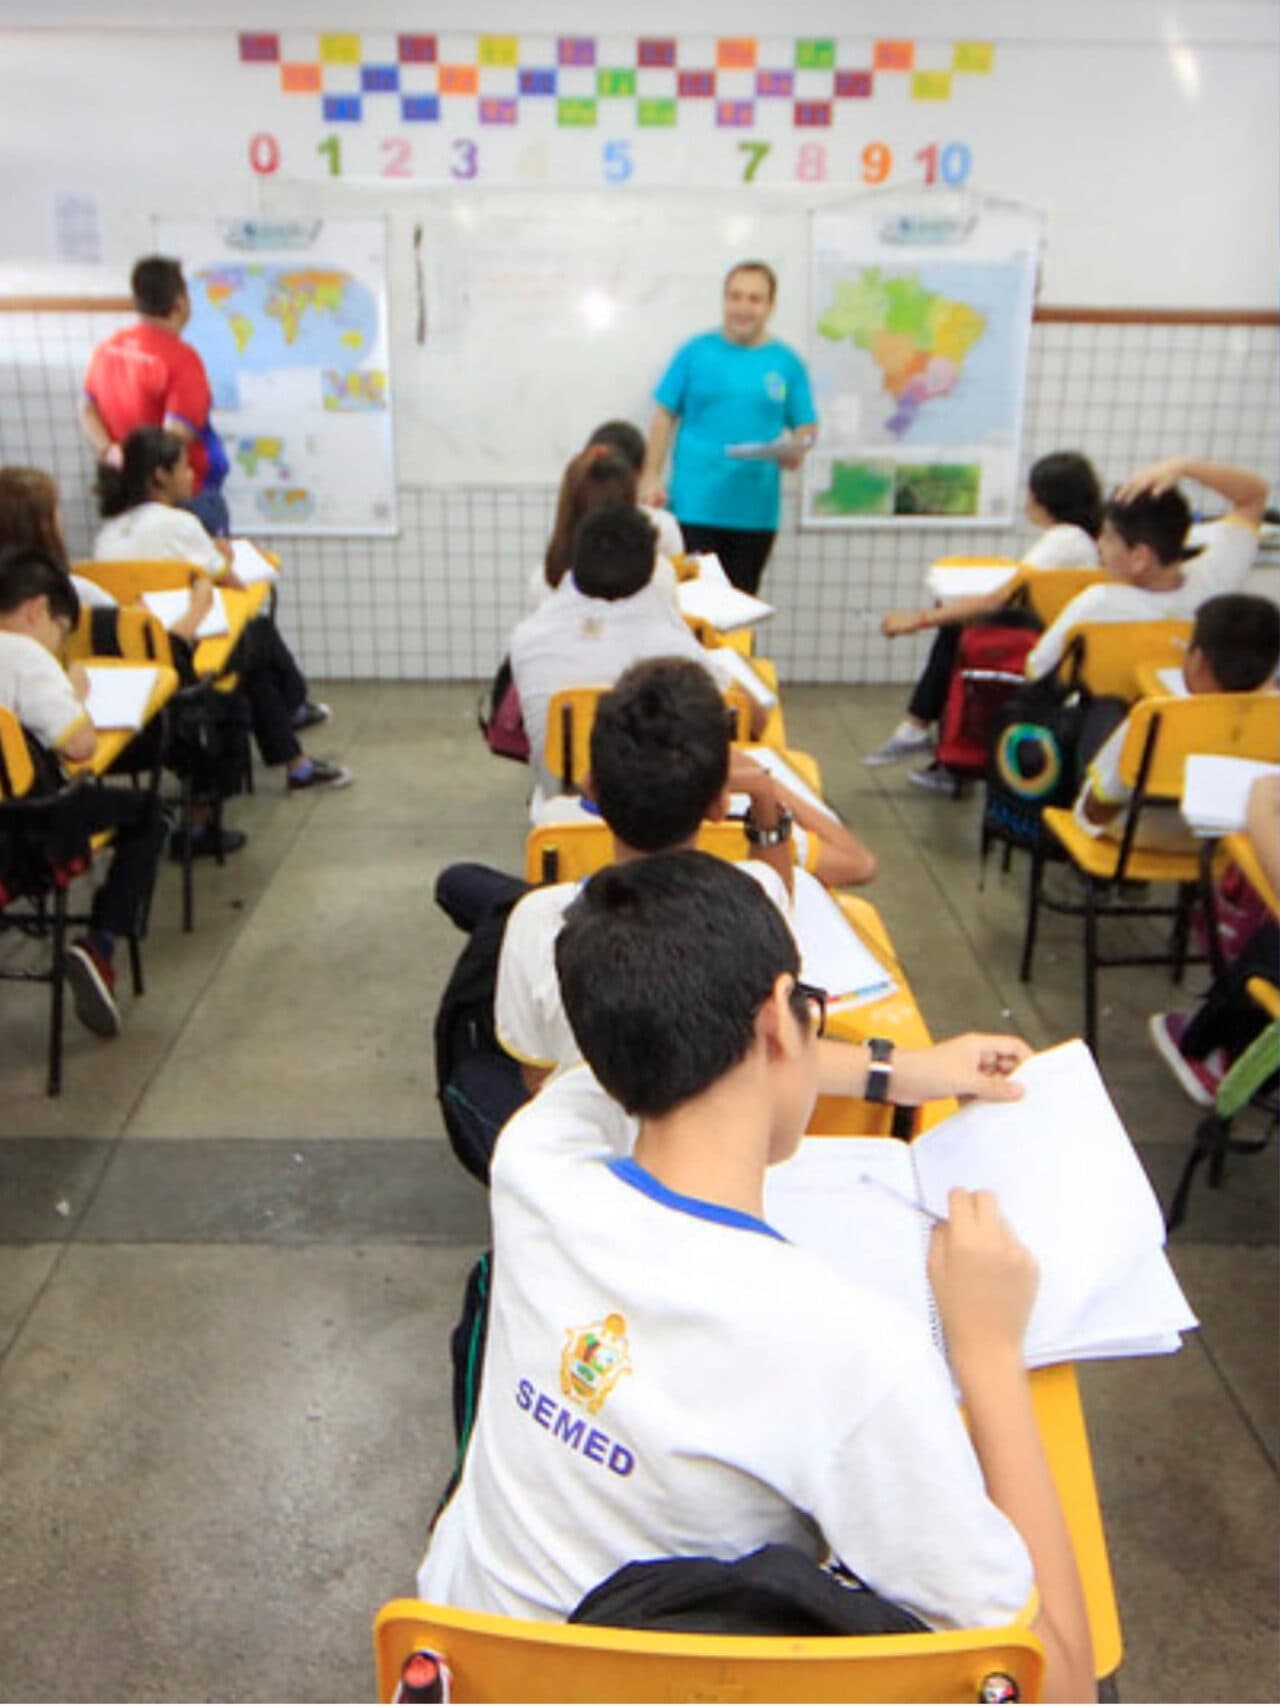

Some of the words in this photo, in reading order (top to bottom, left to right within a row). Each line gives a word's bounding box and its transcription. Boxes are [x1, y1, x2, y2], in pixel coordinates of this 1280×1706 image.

[249, 134, 280, 177] 0
[318, 135, 341, 177] 1
[379, 137, 413, 178] 2
[451, 139, 479, 180] 3
[603, 139, 633, 183] 5
[738, 141, 771, 183] 7
[794, 142, 828, 183] 8
[861, 142, 893, 185] 9
[914, 143, 972, 186] 10
[516, 1377, 635, 1477] SEMED
